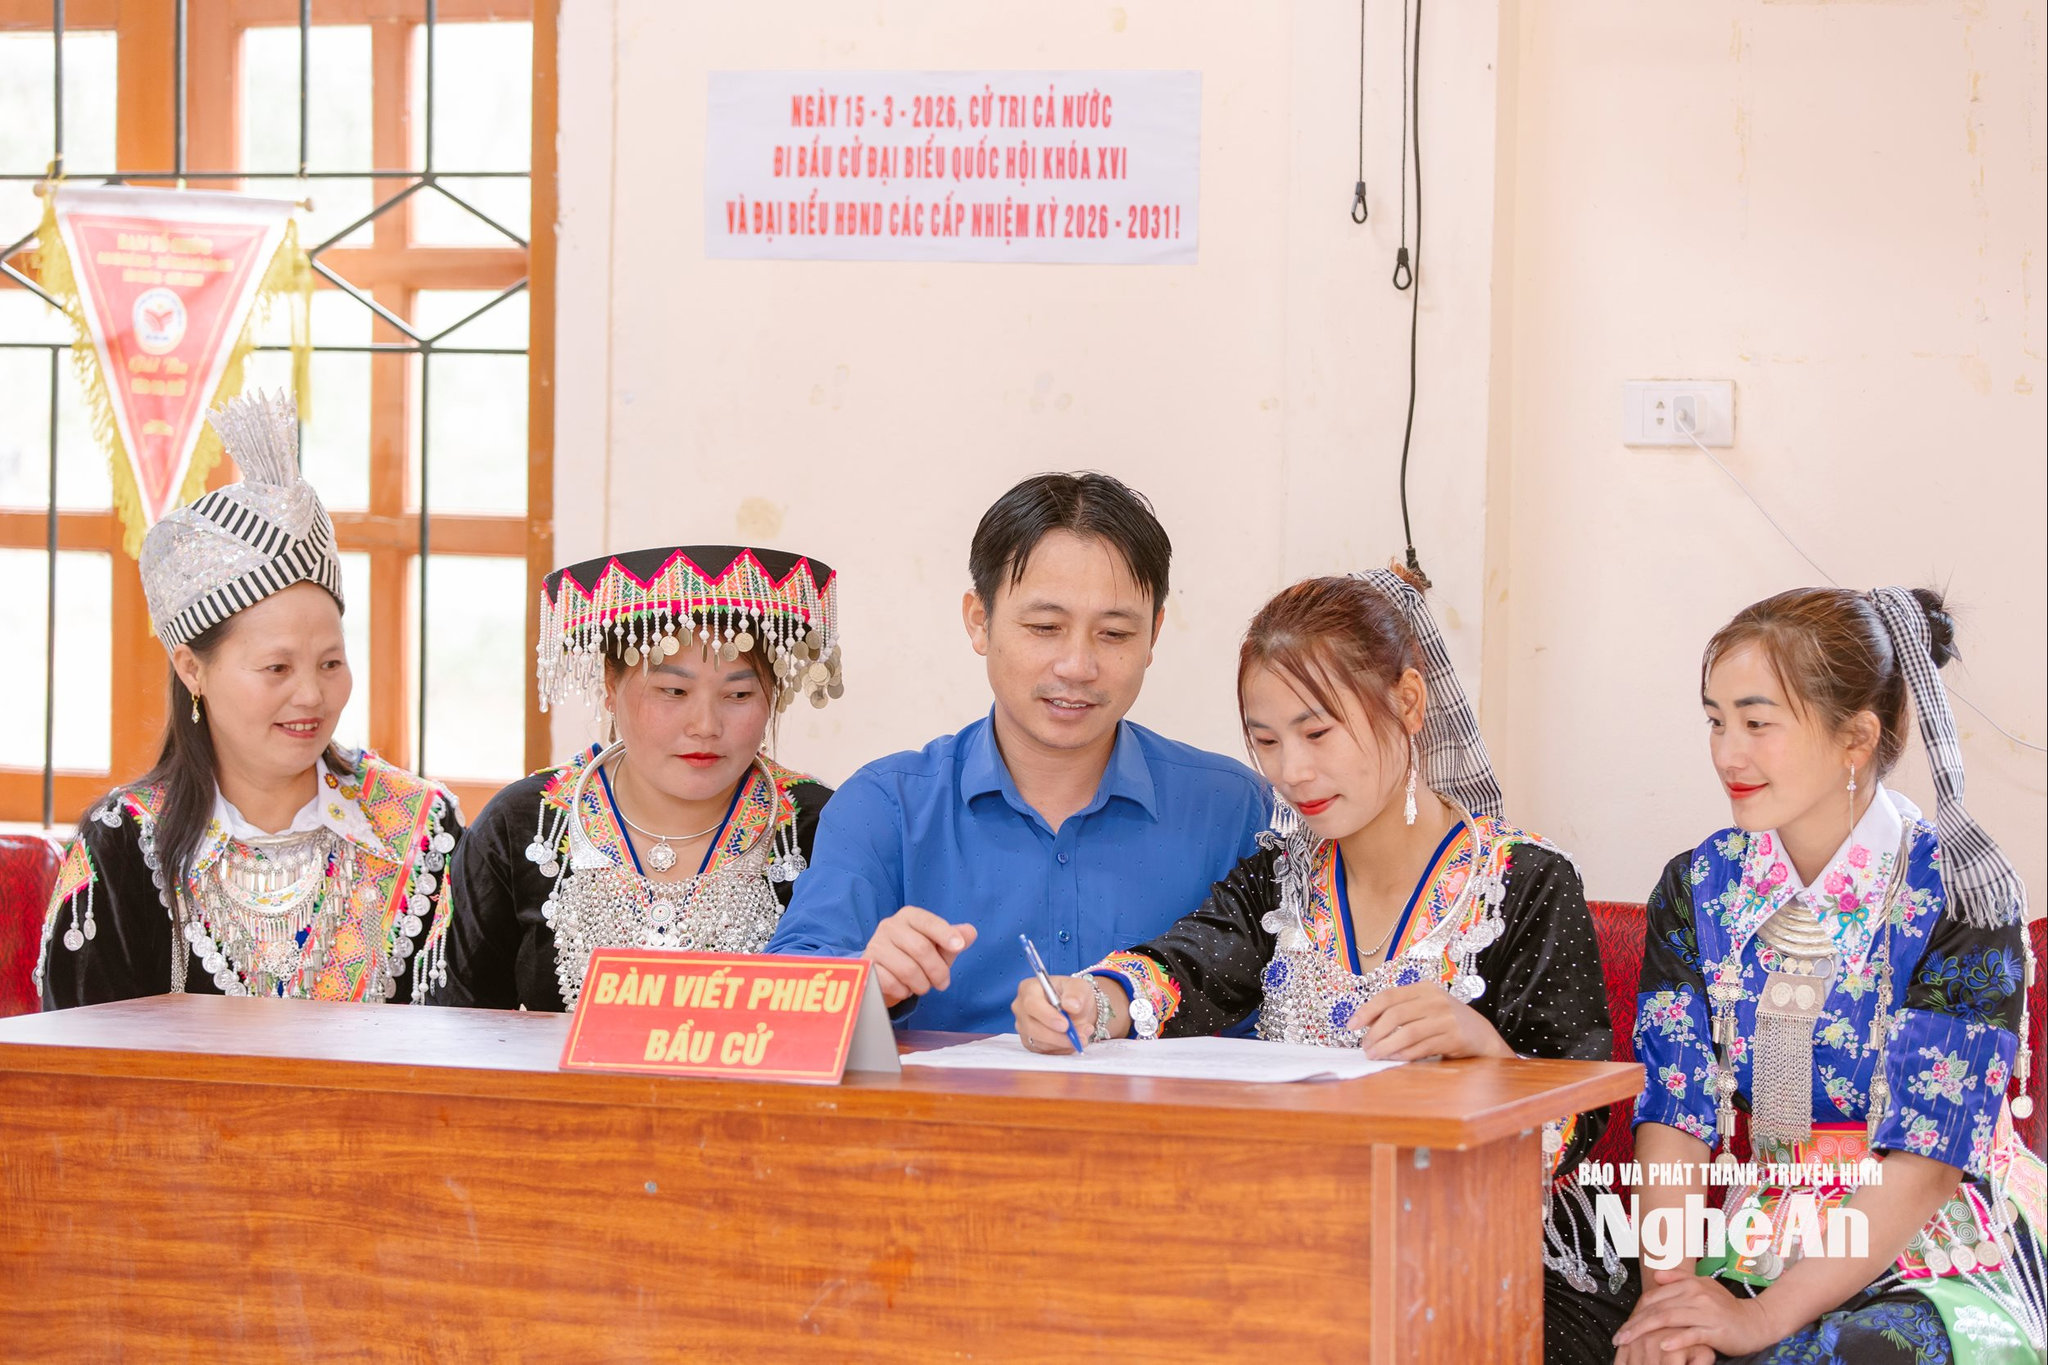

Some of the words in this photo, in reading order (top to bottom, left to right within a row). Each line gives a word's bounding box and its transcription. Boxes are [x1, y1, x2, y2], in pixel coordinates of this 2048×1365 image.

[791, 87, 838, 127] NGÀY
[846, 95, 865, 128] 15
[884, 95, 894, 128] 3
[913, 95, 963, 132] 2026,
[969, 84, 994, 128] CỬ
[998, 95, 1026, 128] TRI
[1062, 88, 1112, 128] NƯỚC
[774, 145, 791, 178] ĐI
[838, 135, 863, 178] CỬ
[868, 145, 898, 186] ĐẠI
[904, 133, 945, 179] BIỂU
[952, 135, 999, 183] QUỐC
[1006, 139, 1036, 187] HỘI
[1043, 139, 1091, 180] KHÓA
[1097, 147, 1127, 180] XVI
[726, 194, 748, 235] VÀ
[753, 201, 782, 243] ĐẠI
[788, 187, 829, 236] BIỂU
[834, 202, 883, 236] HĐND
[889, 195, 924, 237] CÁC
[931, 190, 965, 237] CẤP
[971, 196, 1029, 246] NHIỆM
[1036, 196, 1058, 238] KỲ
[1064, 204, 1108, 239] 2026
[1128, 204, 1180, 239] 2031!
[594, 966, 667, 1007] BÀN
[673, 966, 745, 1010] VIẾT
[747, 969, 850, 1014] PHIẾU
[643, 1018, 716, 1064] BẦU
[720, 1022, 774, 1066] CỬ
